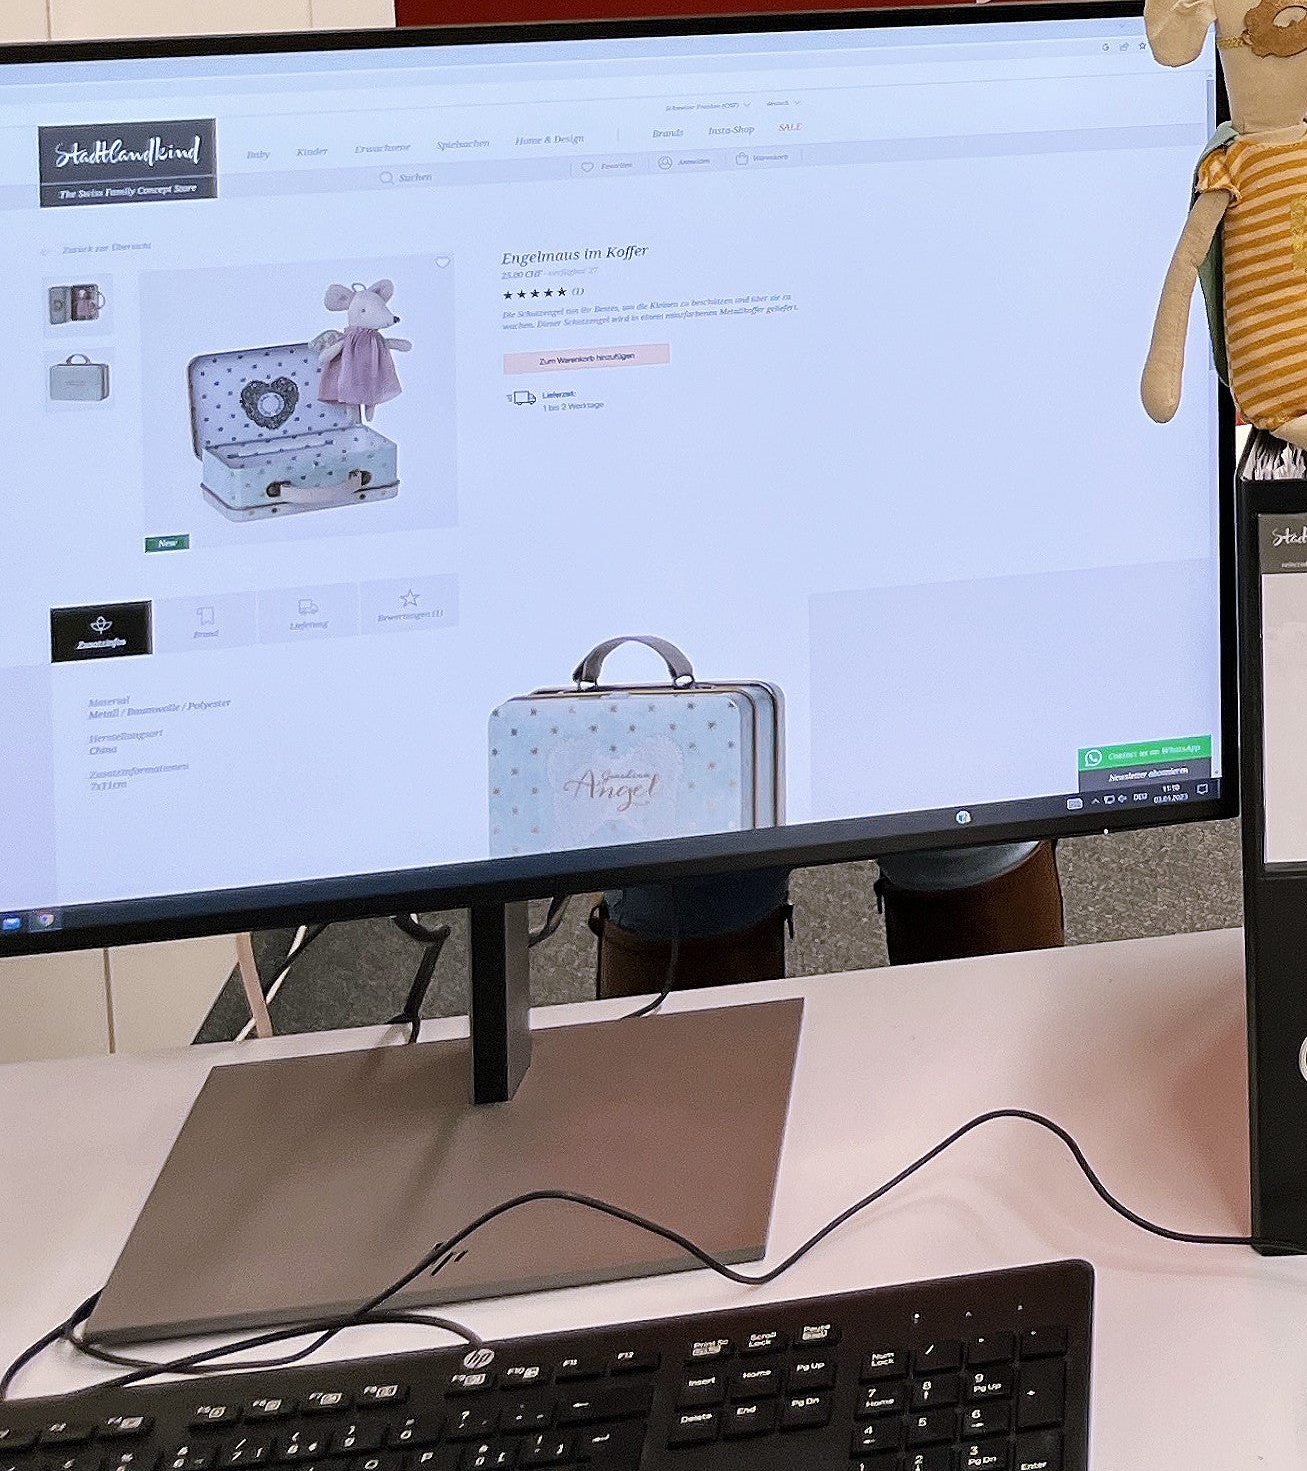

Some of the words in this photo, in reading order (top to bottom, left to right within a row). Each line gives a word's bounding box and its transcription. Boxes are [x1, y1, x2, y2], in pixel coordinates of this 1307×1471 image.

[296, 148, 328, 158] Kinder
[515, 136, 542, 146] Home
[554, 133, 584, 145] Design
[652, 129, 684, 138] Brands
[778, 122, 803, 132] SALE
[55, 135, 200, 168] Stadtlandkind
[399, 173, 432, 183] Suchen
[59, 190, 76, 199] The
[105, 187, 135, 197] Family
[137, 185, 172, 196] Concept
[173, 184, 197, 193] Store
[501, 250, 580, 268] Engelmaus
[584, 247, 601, 260] im
[606, 244, 649, 261] Koffer
[539, 357, 555, 366] Zum
[557, 355, 595, 364] Warenkorb
[158, 538, 178, 548] New
[187, 699, 232, 711] Polyester
[1162, 745, 1201, 756] WhatsApp
[563, 769, 659, 812] Angel
[464, 1348, 494, 1369] hp
[796, 1362, 809, 1373] Pg
[810, 1361, 825, 1371] Up
[868, 1388, 876, 1397] 7
[987, 1382, 1002, 1392] Up
[791, 1398, 804, 1409] Pg
[736, 1405, 757, 1416] End
[918, 1417, 927, 1427] 5
[969, 1446, 978, 1456] 3
